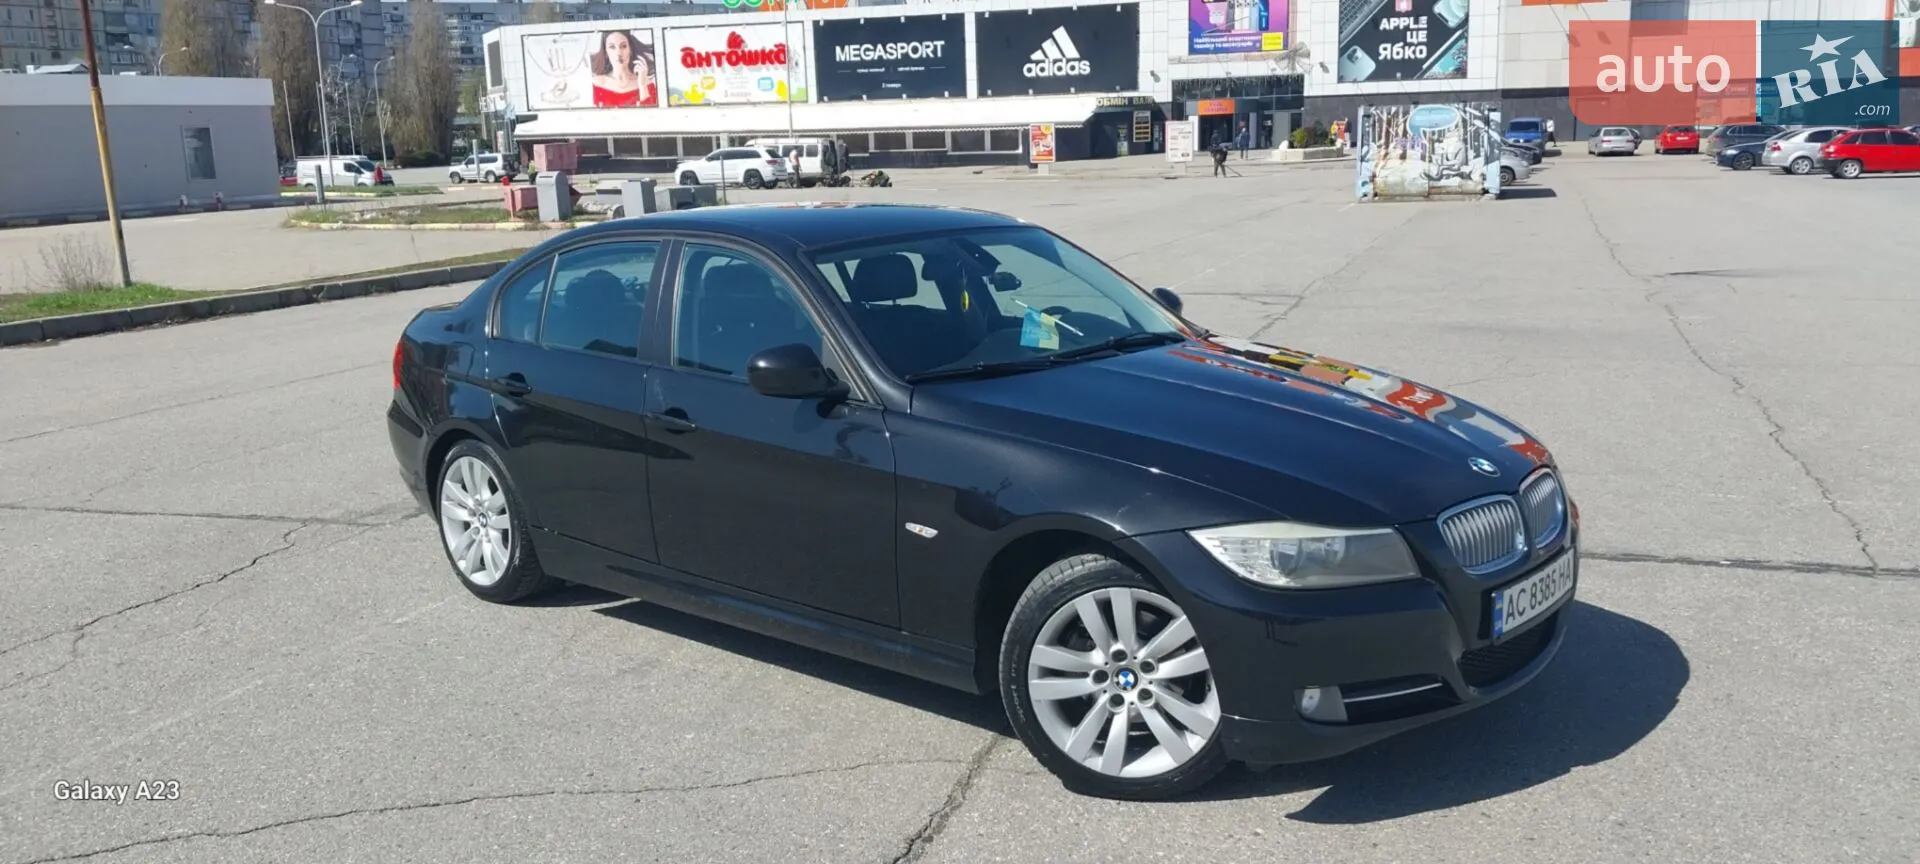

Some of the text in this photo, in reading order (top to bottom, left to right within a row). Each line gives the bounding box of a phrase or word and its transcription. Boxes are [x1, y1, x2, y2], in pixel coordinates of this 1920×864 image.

[1379, 16, 1428, 30] APPLE
[1406, 30, 1428, 44] ЦЕ
[835, 40, 945, 62] MEGASPORT
[1023, 57, 1091, 78] adidas
[1097, 96, 1128, 107] ОБМІН
[1505, 557, 1571, 625] AC 8385 HA
